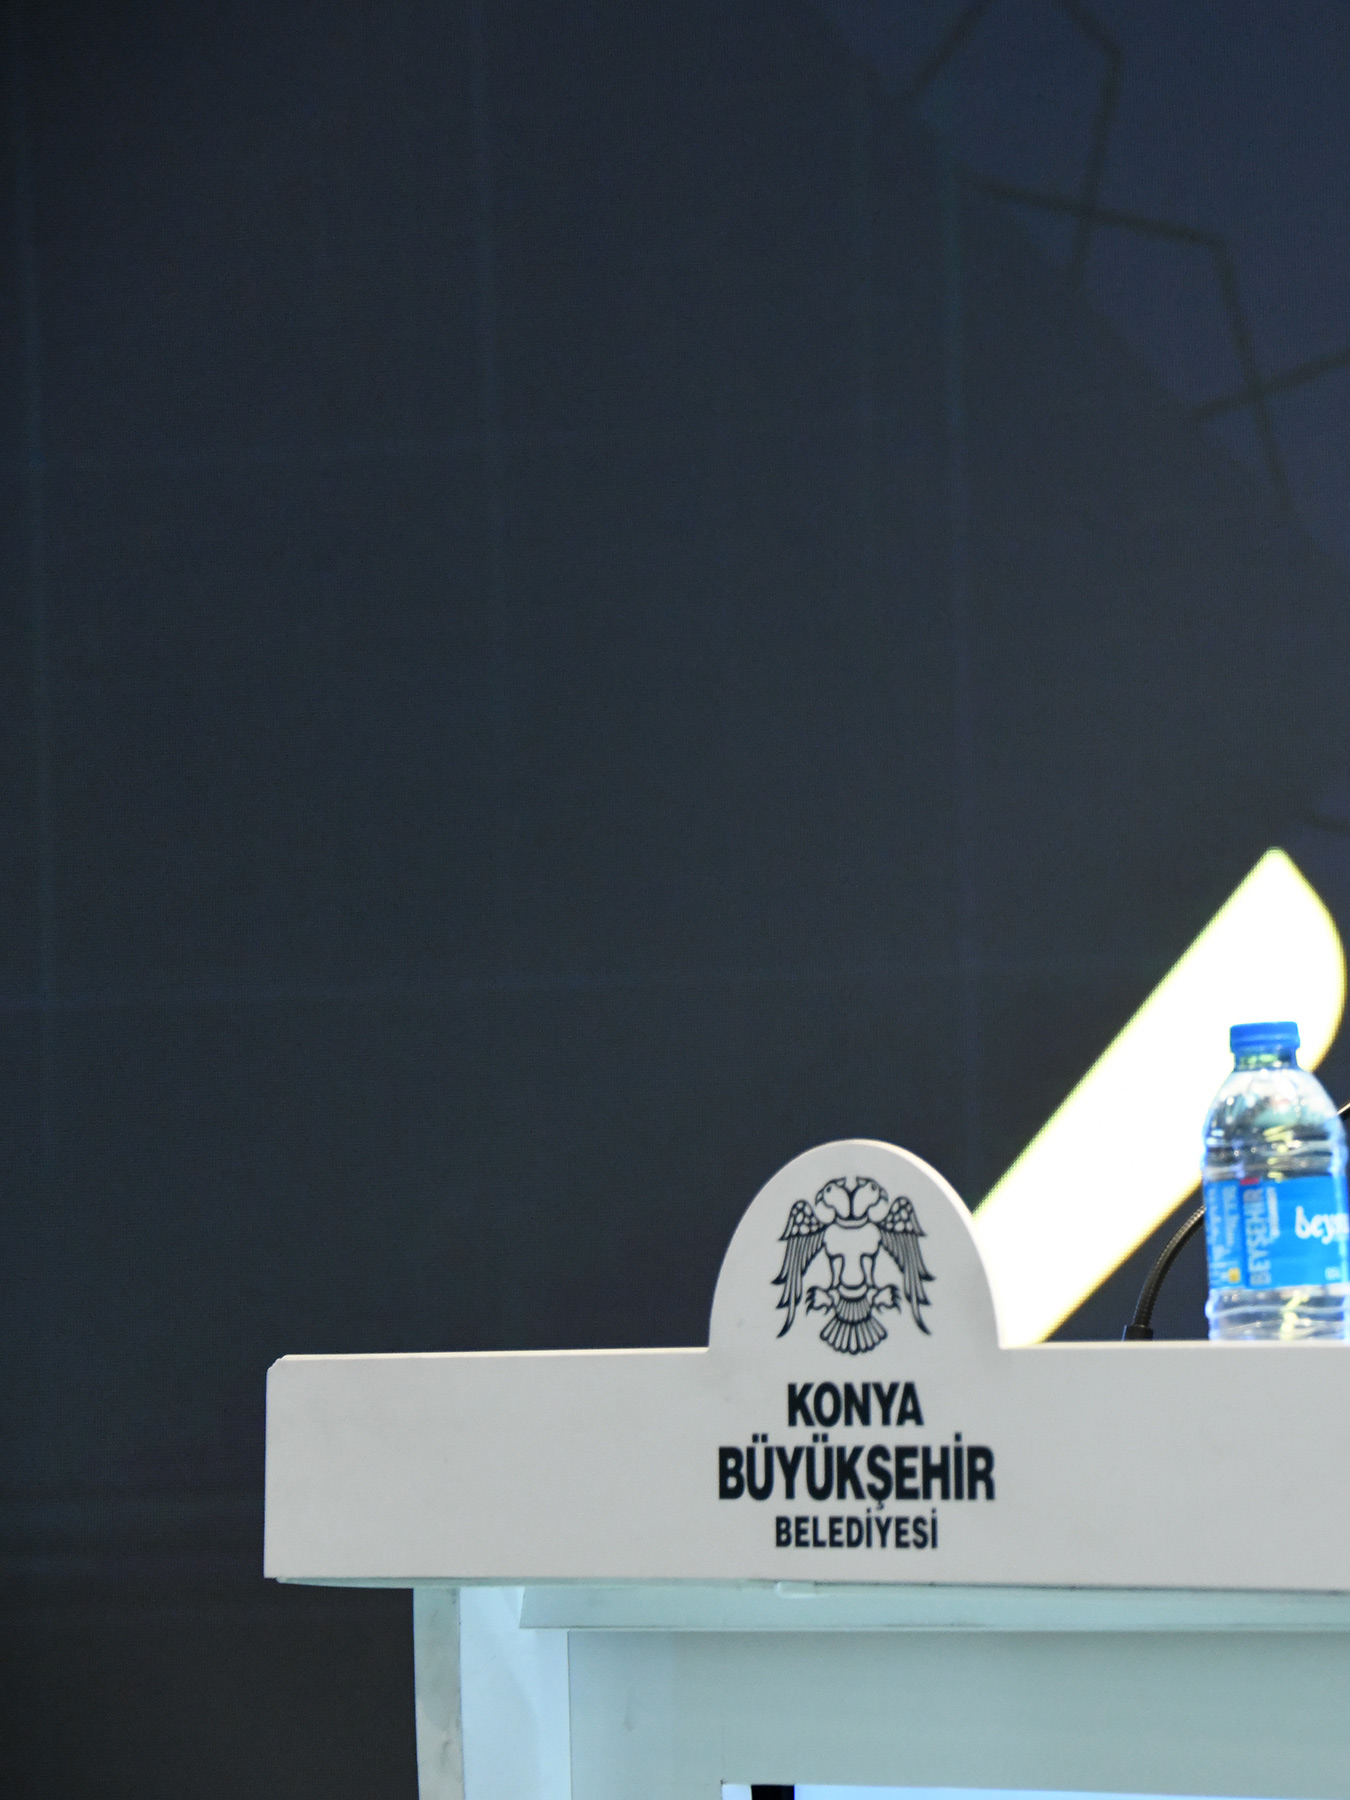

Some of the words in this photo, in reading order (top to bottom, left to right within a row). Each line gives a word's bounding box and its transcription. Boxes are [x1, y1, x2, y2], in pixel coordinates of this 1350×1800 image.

[787, 1381, 924, 1427] KONYA
[718, 1431, 996, 1510] BÜYÜKŞEHİR
[775, 1507, 938, 1549] BELEDİYESİ
